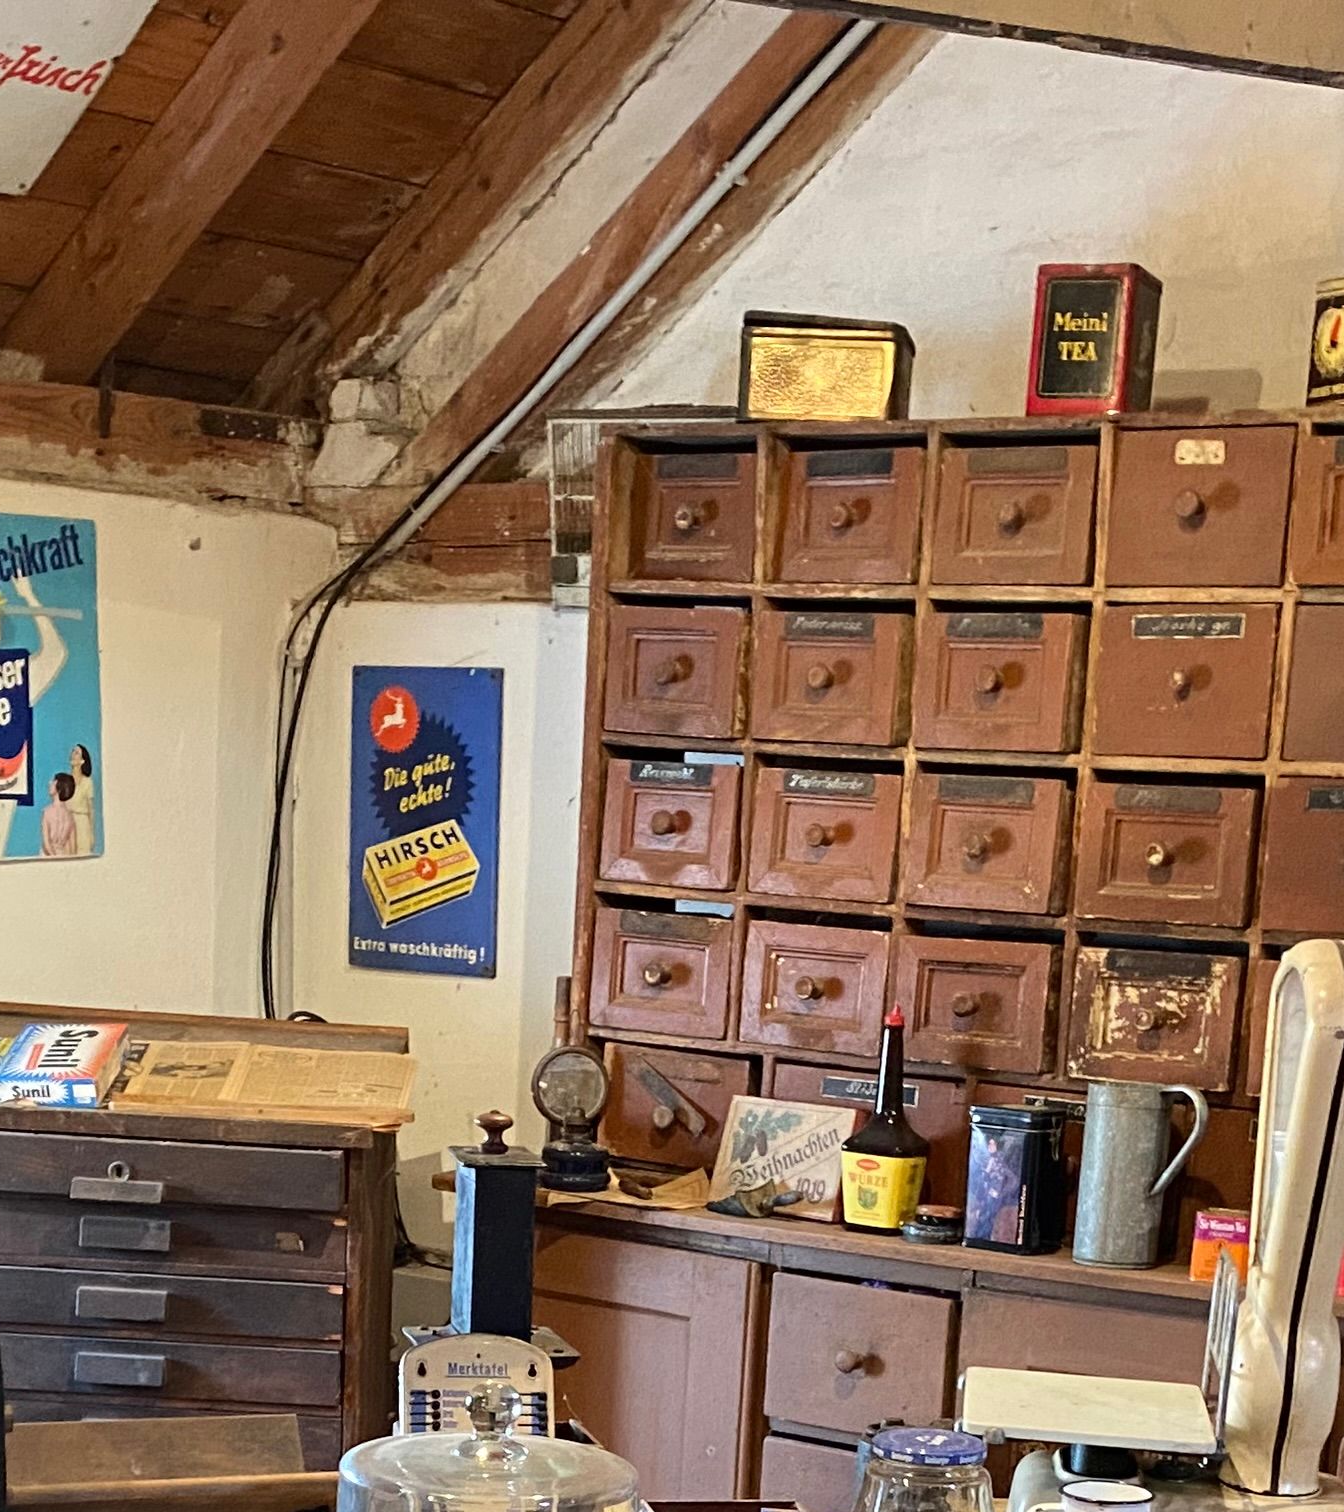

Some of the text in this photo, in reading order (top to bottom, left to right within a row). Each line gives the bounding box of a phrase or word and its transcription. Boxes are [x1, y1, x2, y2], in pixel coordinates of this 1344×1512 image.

[1058, 341, 1099, 361] TEA
[384, 766, 408, 791] Die
[374, 827, 461, 870] HIRSCH
[353, 936, 385, 952] Extra
[38, 1029, 99, 1068] Sunil
[11, 1085, 51, 1099] Sunil
[730, 1128, 841, 1190] Weihnachten
[447, 1362, 509, 1376] Merktafel
